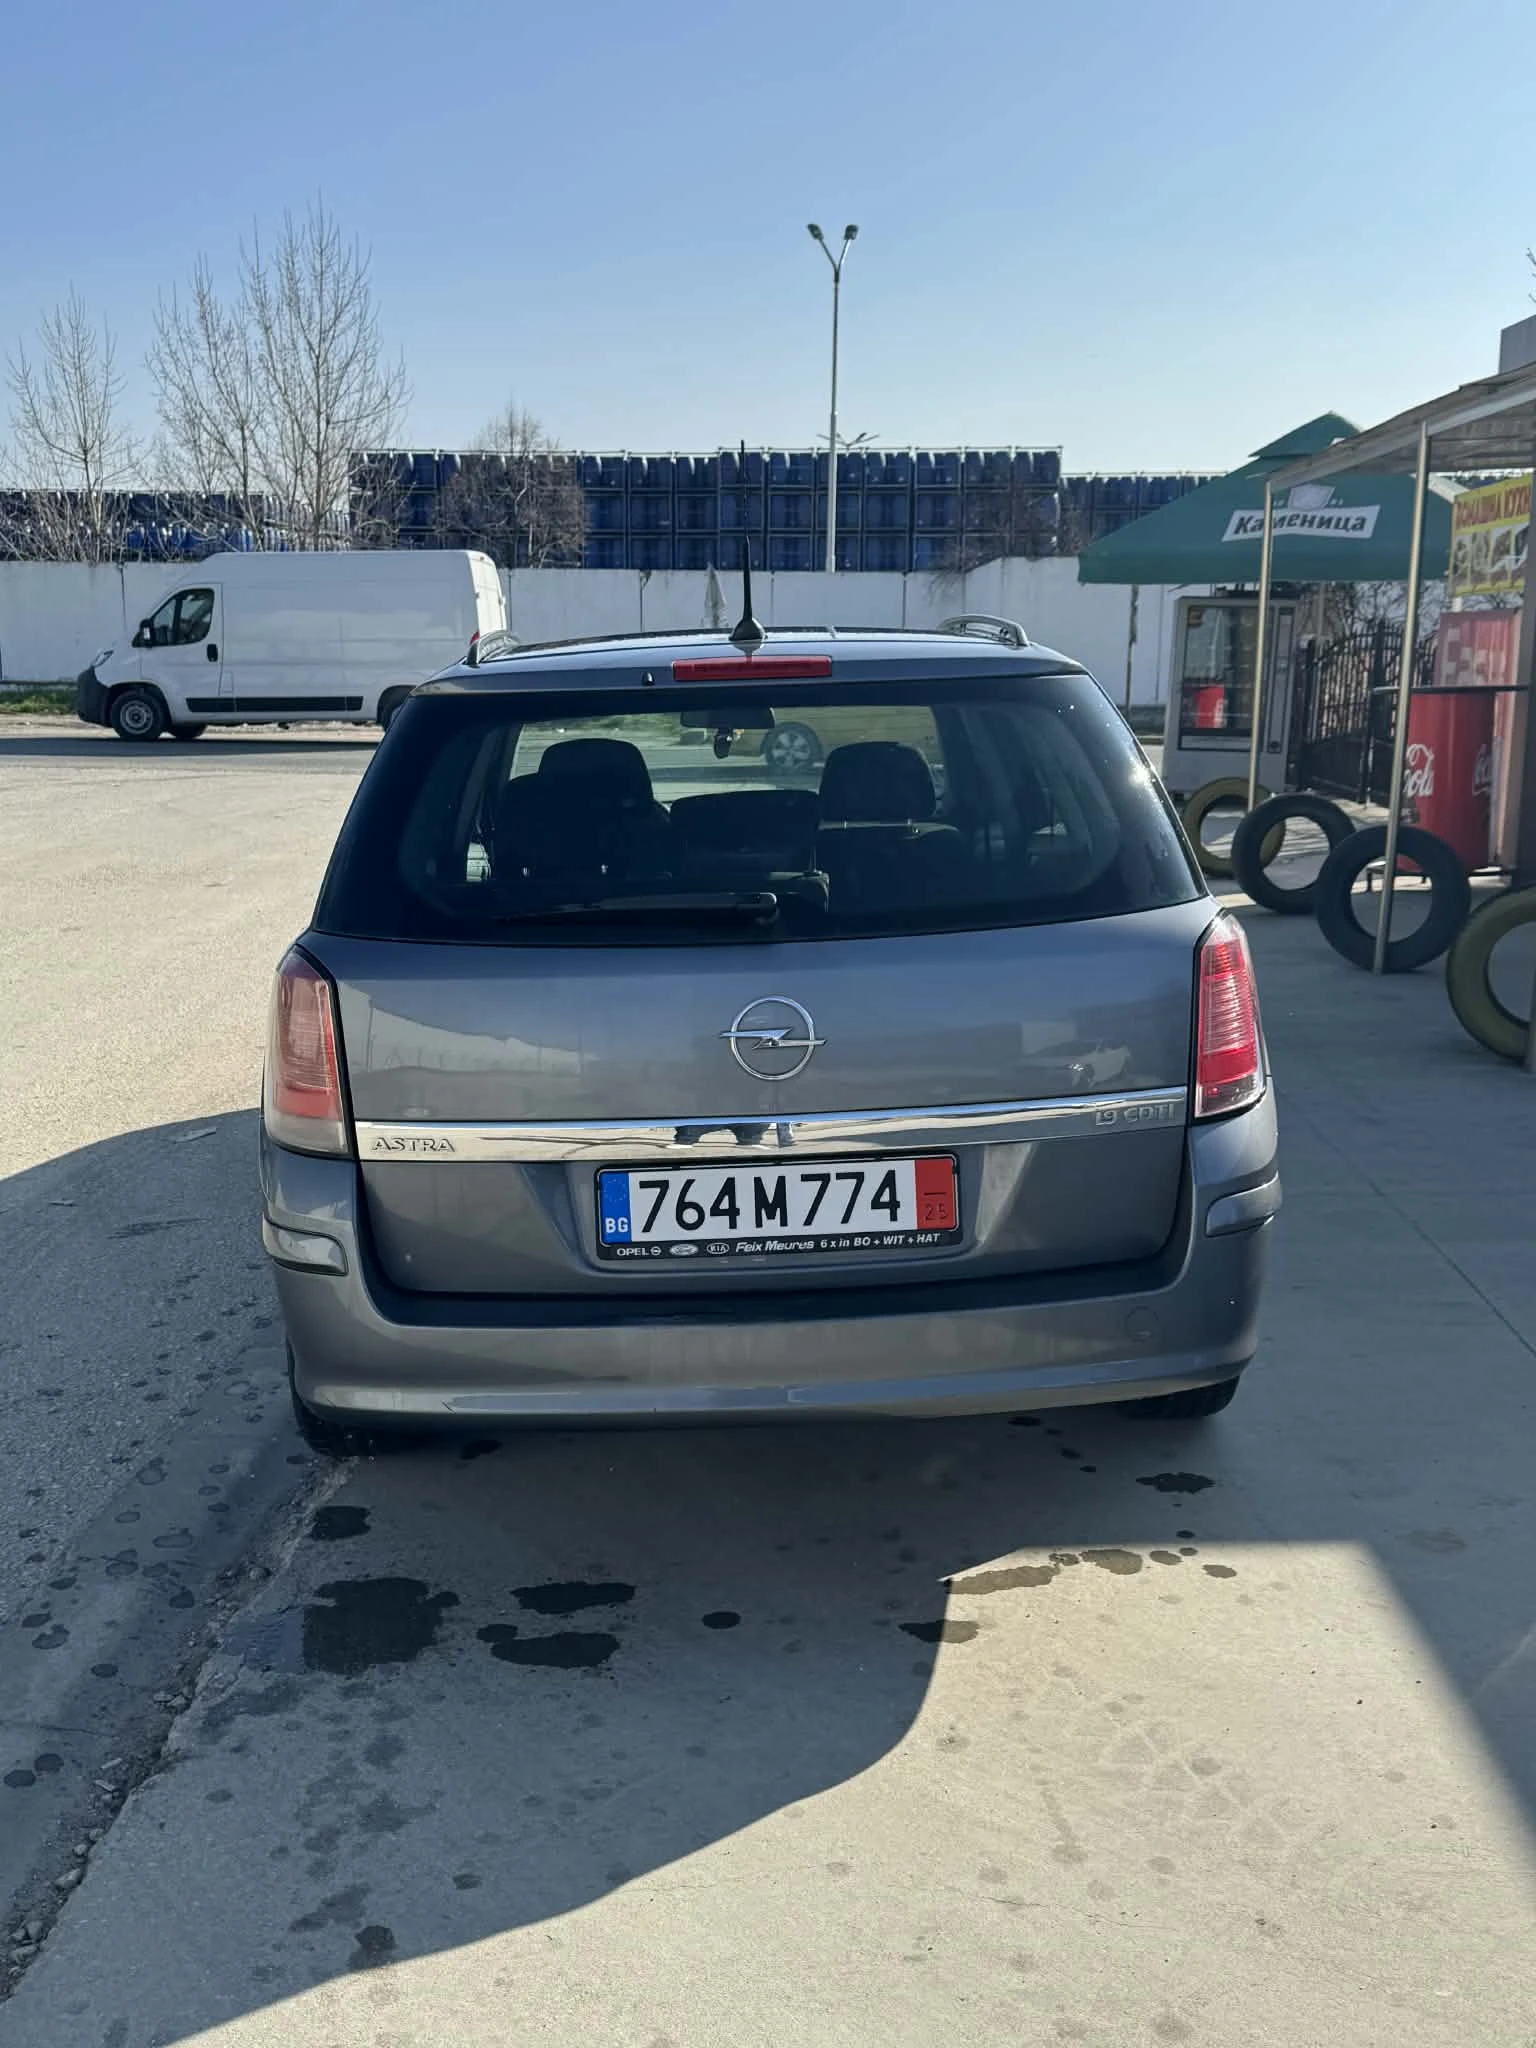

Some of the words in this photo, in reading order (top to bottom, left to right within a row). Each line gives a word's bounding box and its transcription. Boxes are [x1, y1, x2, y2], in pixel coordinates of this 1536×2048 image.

[371, 1136, 456, 1153] ASTRA
[924, 1202, 949, 1221] 25
[605, 1217, 629, 1234] BG
[820, 1239, 828, 1248] 6
[839, 1238, 850, 1247] in
[853, 1236, 871, 1247] BO
[883, 1234, 905, 1245] WIT
[916, 1233, 941, 1243] HAT
[616, 1247, 650, 1257] OPEL
